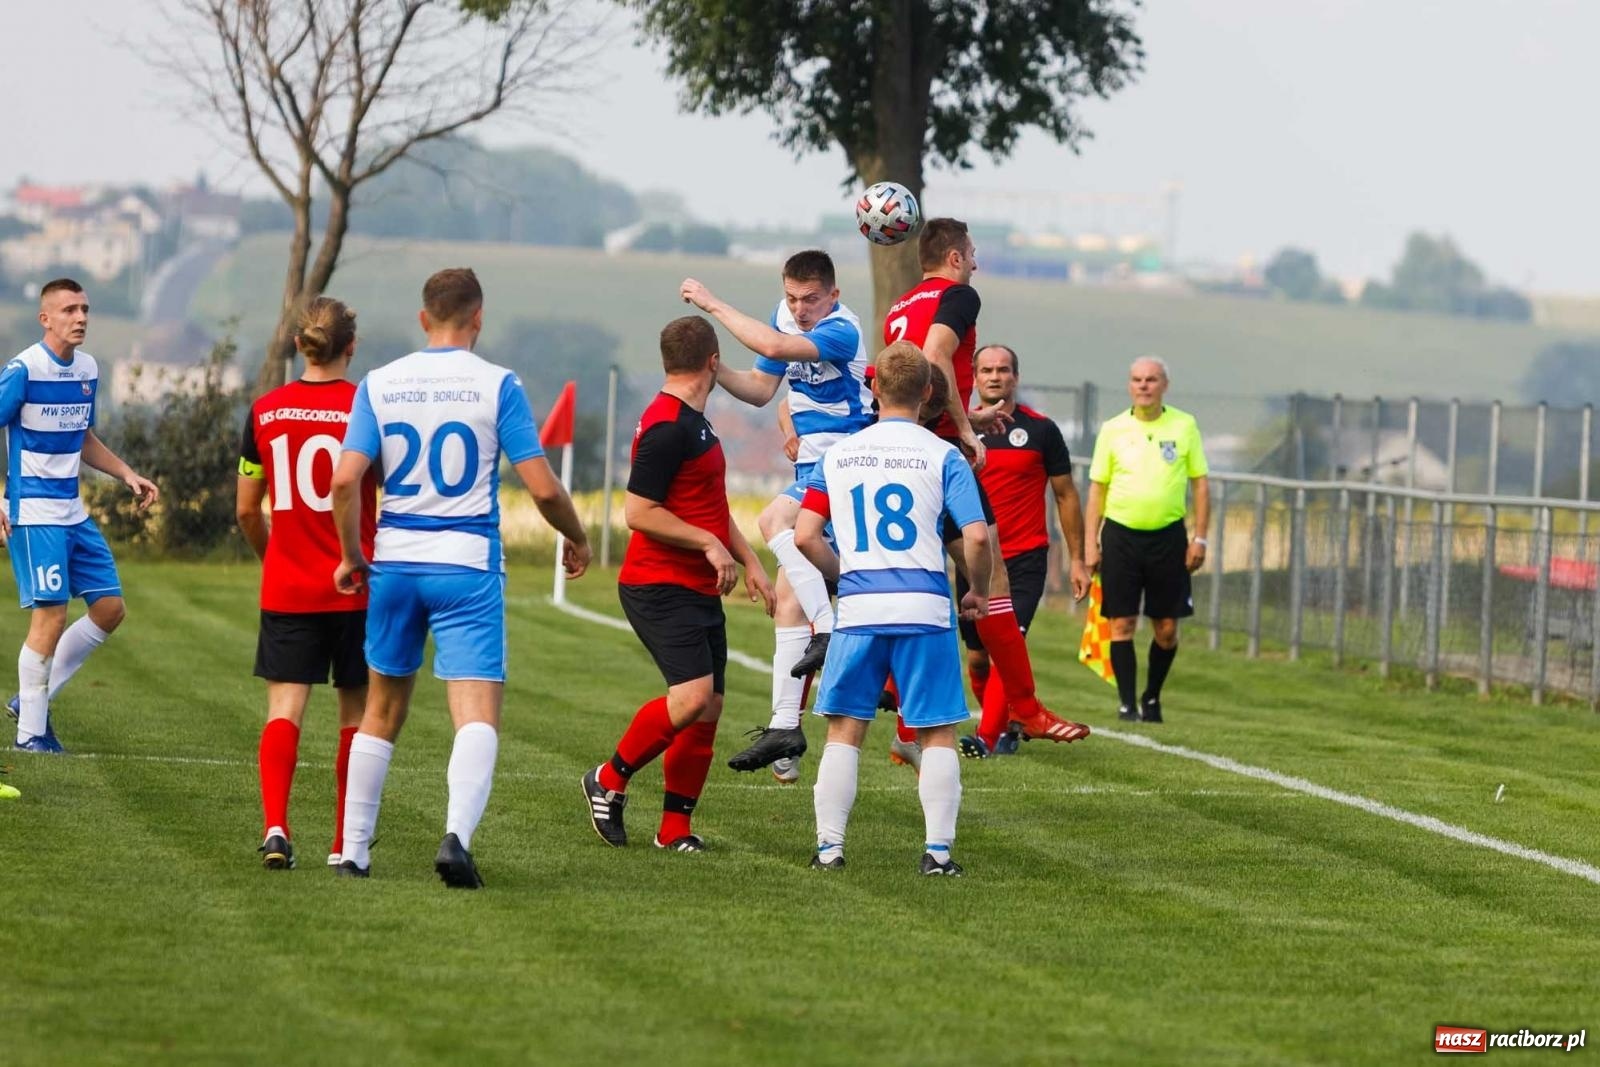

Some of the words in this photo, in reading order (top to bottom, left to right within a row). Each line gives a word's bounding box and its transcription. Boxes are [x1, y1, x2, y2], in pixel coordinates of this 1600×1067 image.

[433, 390, 480, 403] BORUCIN
[41, 407, 59, 417] MW
[61, 406, 86, 416] SPORT
[269, 433, 342, 512] 10
[383, 421, 479, 497] 20
[837, 454, 878, 469] NAPRZÓD
[884, 458, 928, 470] BORUCIN
[849, 483, 918, 552] 18
[36, 564, 62, 592] 16
